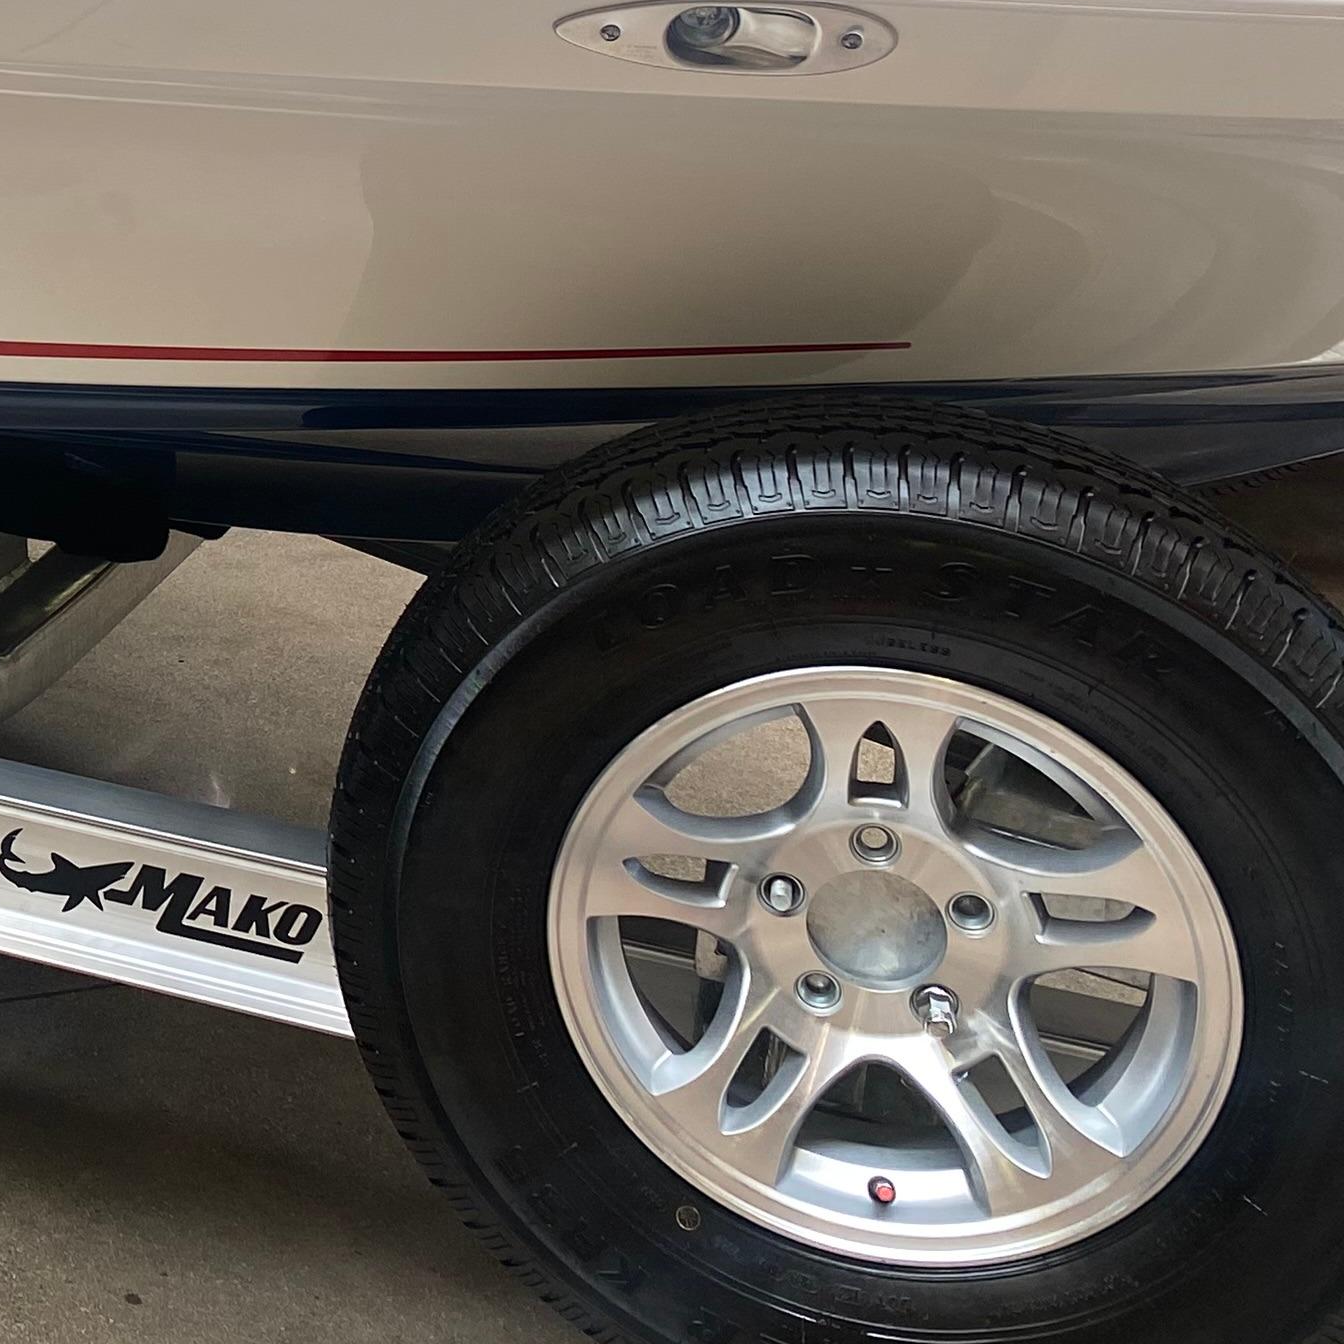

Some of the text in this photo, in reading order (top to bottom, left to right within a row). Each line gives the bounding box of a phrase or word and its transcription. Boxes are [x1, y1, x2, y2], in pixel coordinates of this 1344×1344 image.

[594, 552, 1178, 675] LOAD STAR
[102, 863, 324, 965] MAKO
